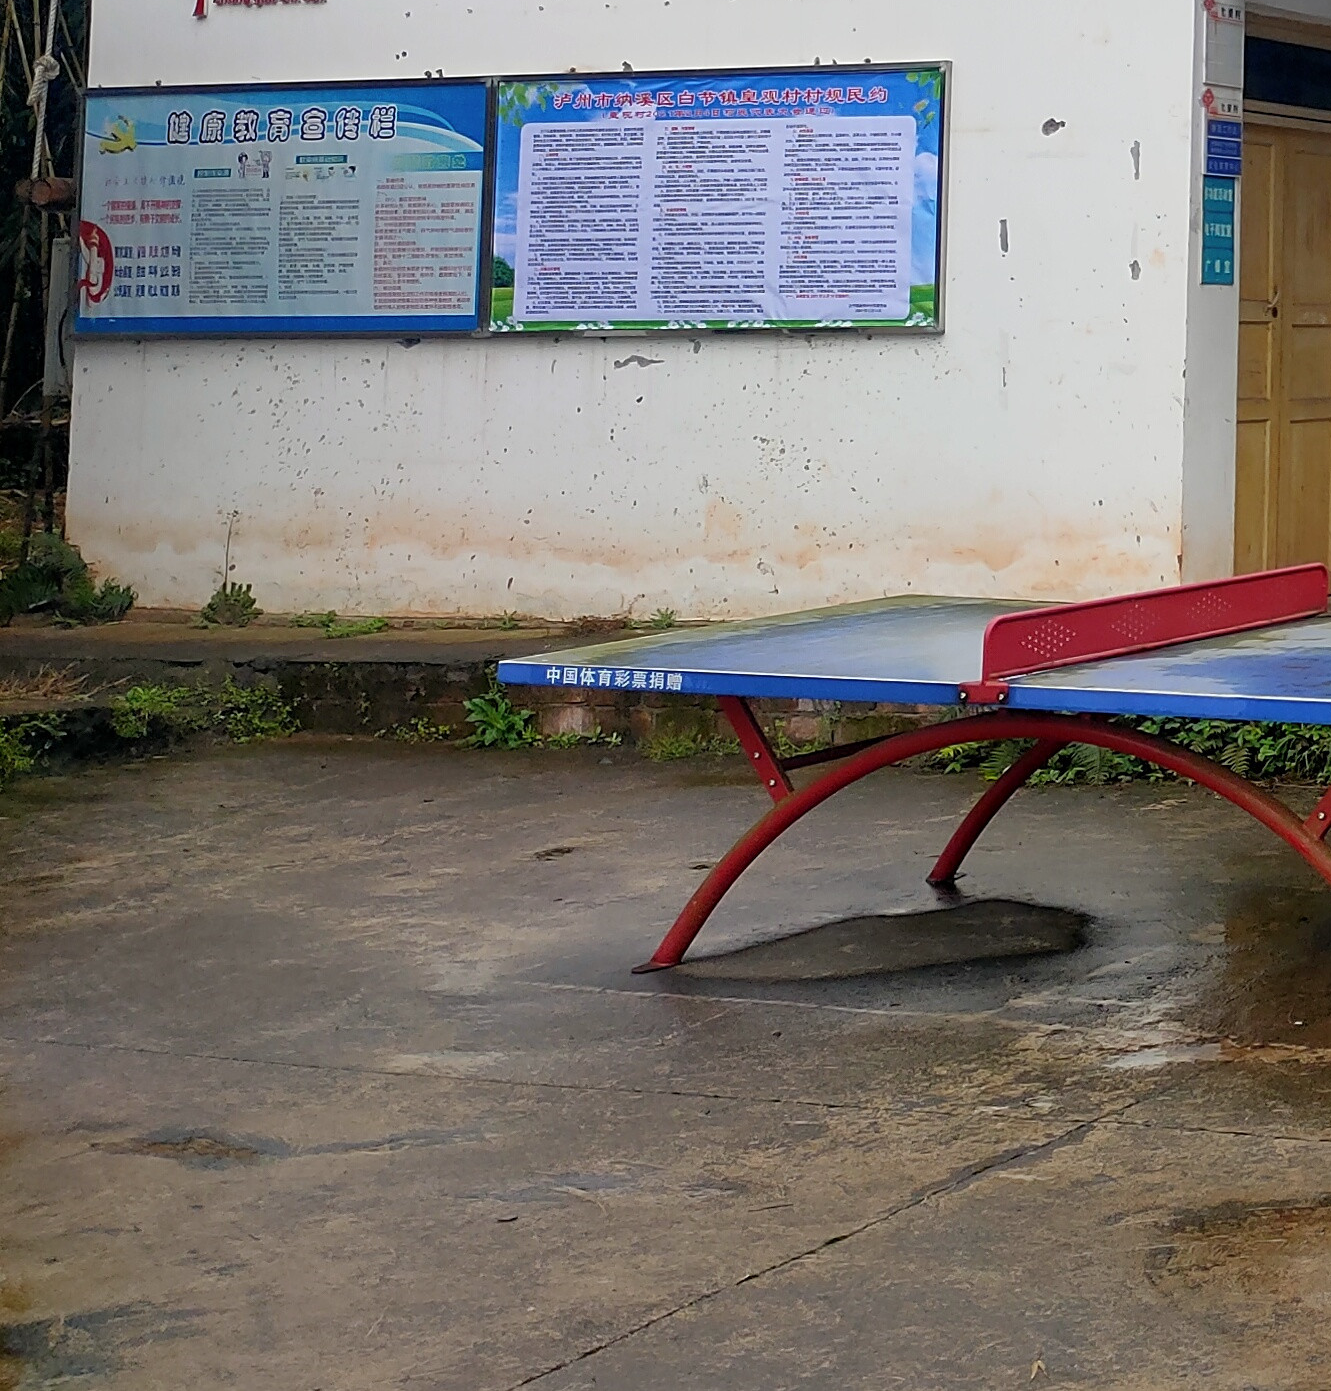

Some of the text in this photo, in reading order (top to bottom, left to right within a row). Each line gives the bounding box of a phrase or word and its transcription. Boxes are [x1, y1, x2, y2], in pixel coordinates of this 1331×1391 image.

[553, 85, 889, 109] 泸州市纳溪区白节镇皇观村村规民约
[165, 104, 398, 145] 健康教育宣传栏
[546, 666, 683, 690] 中国体育彩票捐赠
